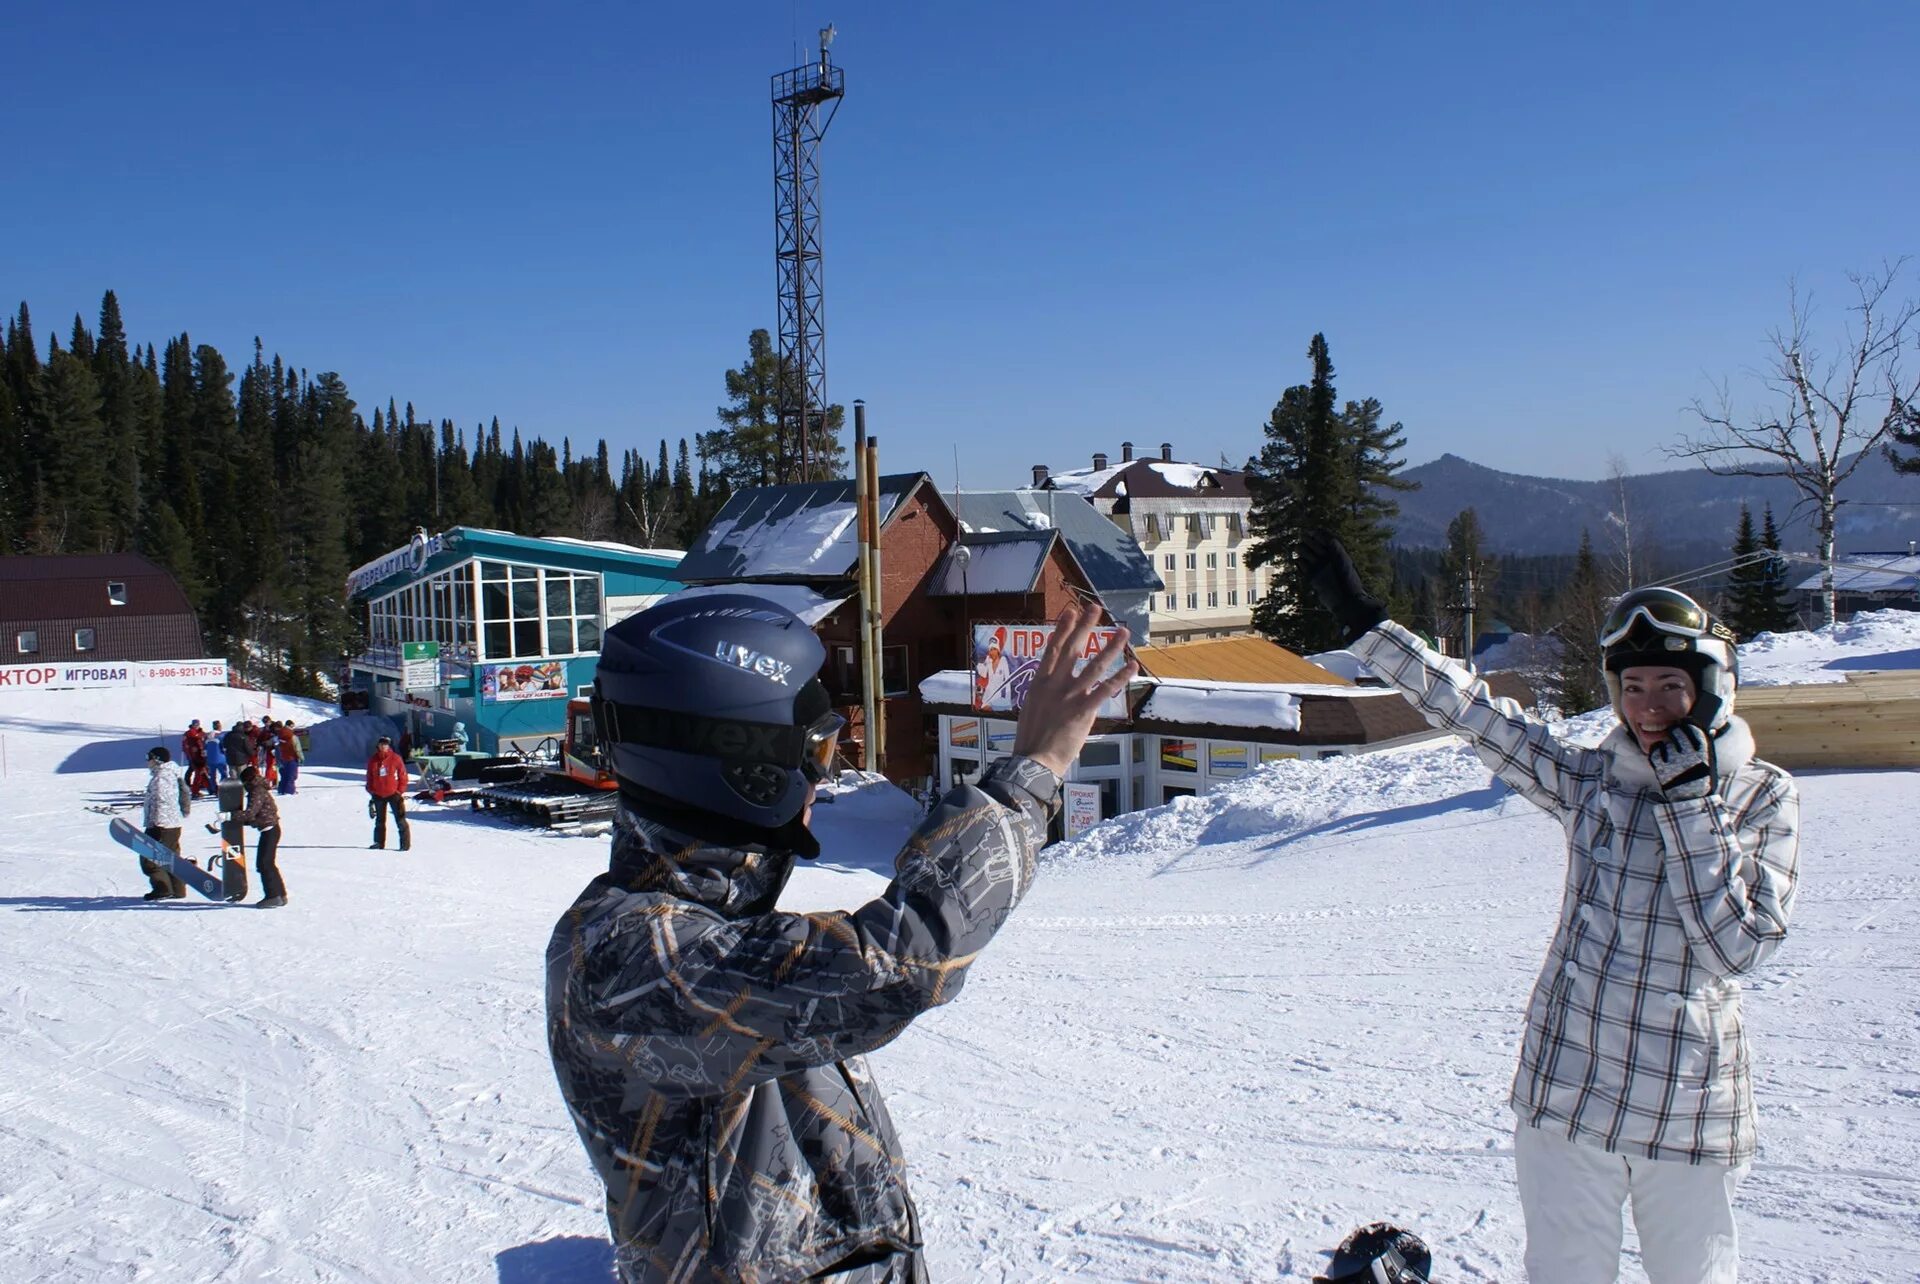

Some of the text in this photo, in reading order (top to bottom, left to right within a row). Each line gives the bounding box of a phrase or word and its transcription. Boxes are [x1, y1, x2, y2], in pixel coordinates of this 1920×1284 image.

[0, 667, 223, 686] КТОР ИГРОВАЯ 8-906-921-17-55
[715, 640, 792, 687] uvex
